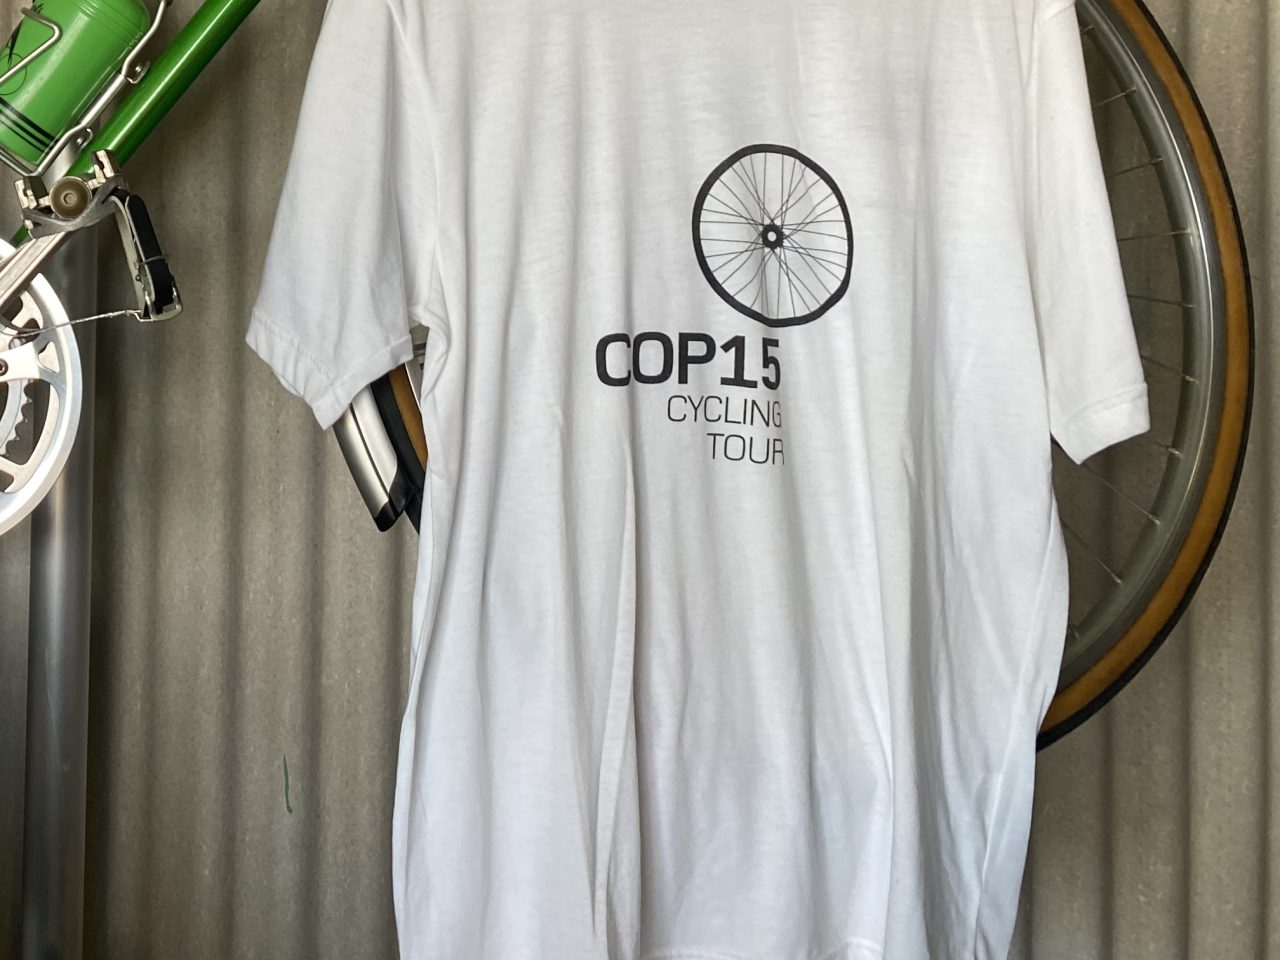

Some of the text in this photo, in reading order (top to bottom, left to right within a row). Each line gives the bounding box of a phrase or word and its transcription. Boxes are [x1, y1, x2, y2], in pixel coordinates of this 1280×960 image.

[595, 331, 781, 390] COP15
[667, 395, 782, 428] CYCLING
[706, 432, 785, 465] TOUR
